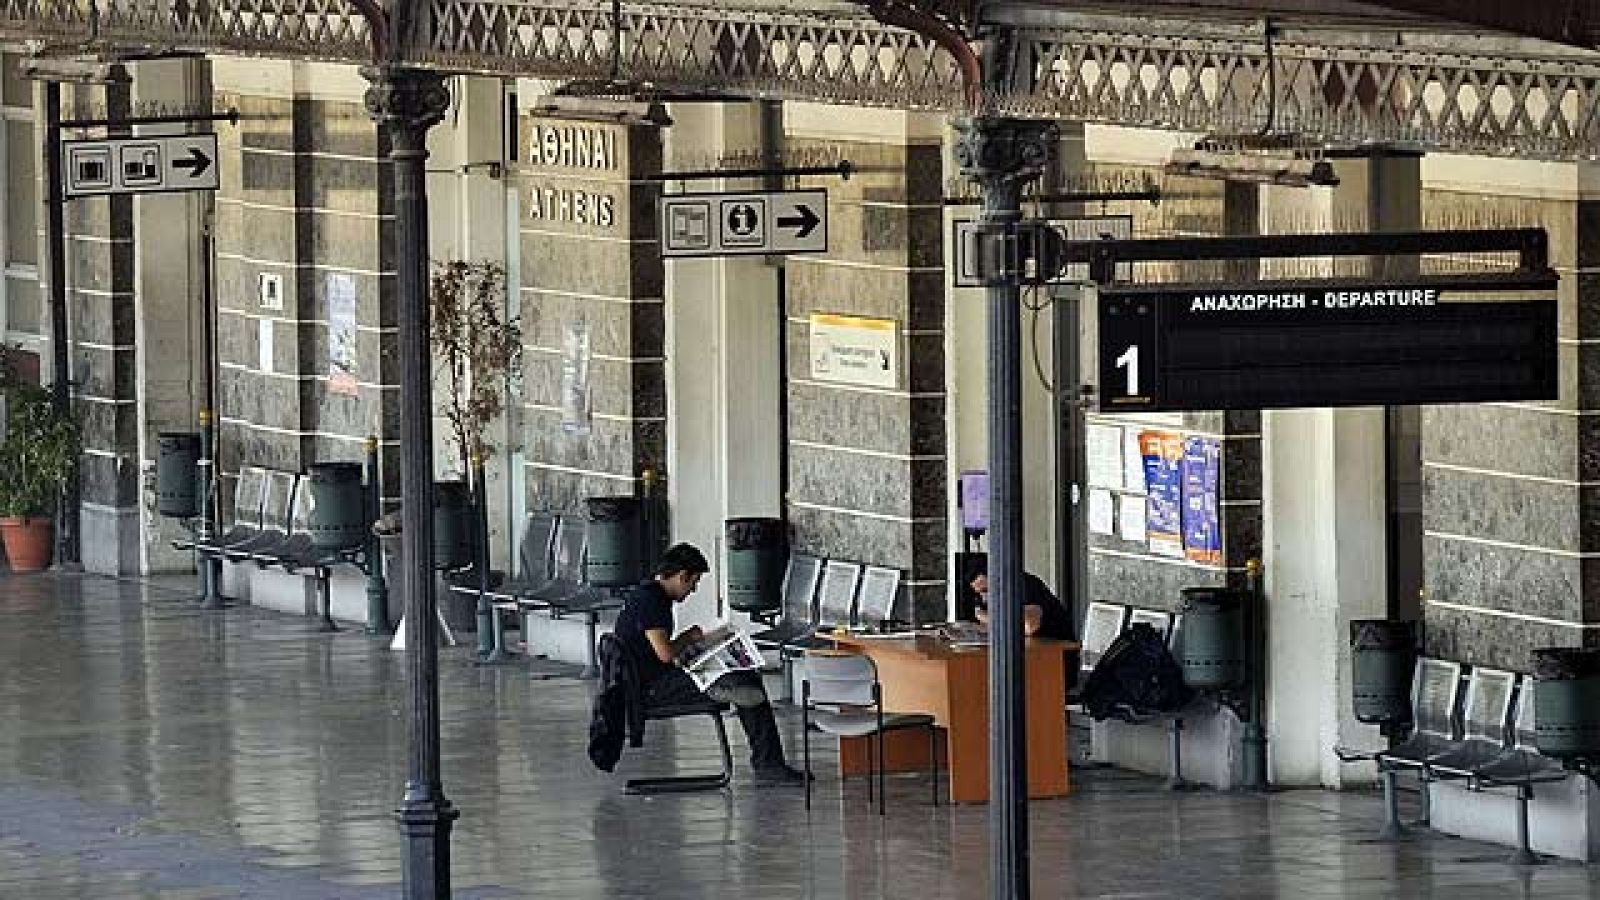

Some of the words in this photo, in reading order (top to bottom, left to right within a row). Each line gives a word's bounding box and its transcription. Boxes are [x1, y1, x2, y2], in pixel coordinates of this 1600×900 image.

[530, 126, 616, 169] ΑΘΗΝΑΙ
[530, 188, 614, 226] ATHENS
[1190, 294, 1306, 311] ΑΝΑΧΩΡΗΣΗ
[1325, 289, 1436, 308] DEPARTURE
[1116, 344, 1139, 395] 1
